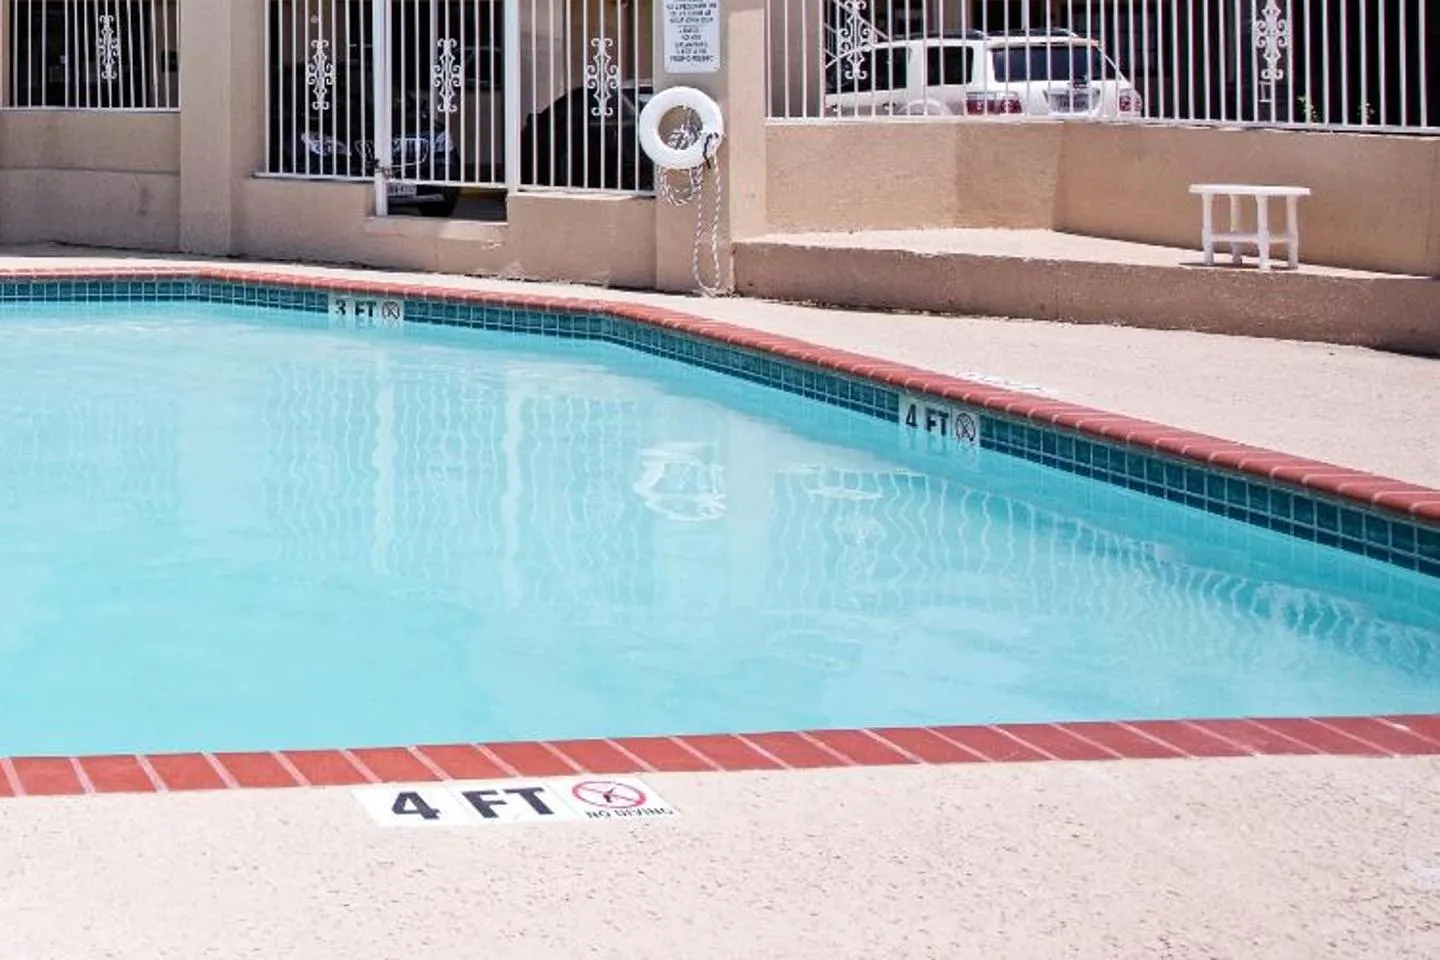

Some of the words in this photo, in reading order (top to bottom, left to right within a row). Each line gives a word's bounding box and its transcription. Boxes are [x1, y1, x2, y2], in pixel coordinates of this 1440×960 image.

[335, 299, 346, 315] 3
[354, 300, 377, 317] FT
[905, 403, 918, 427] 4
[925, 406, 949, 437] FT
[392, 791, 441, 820] 4
[462, 787, 555, 818] FT
